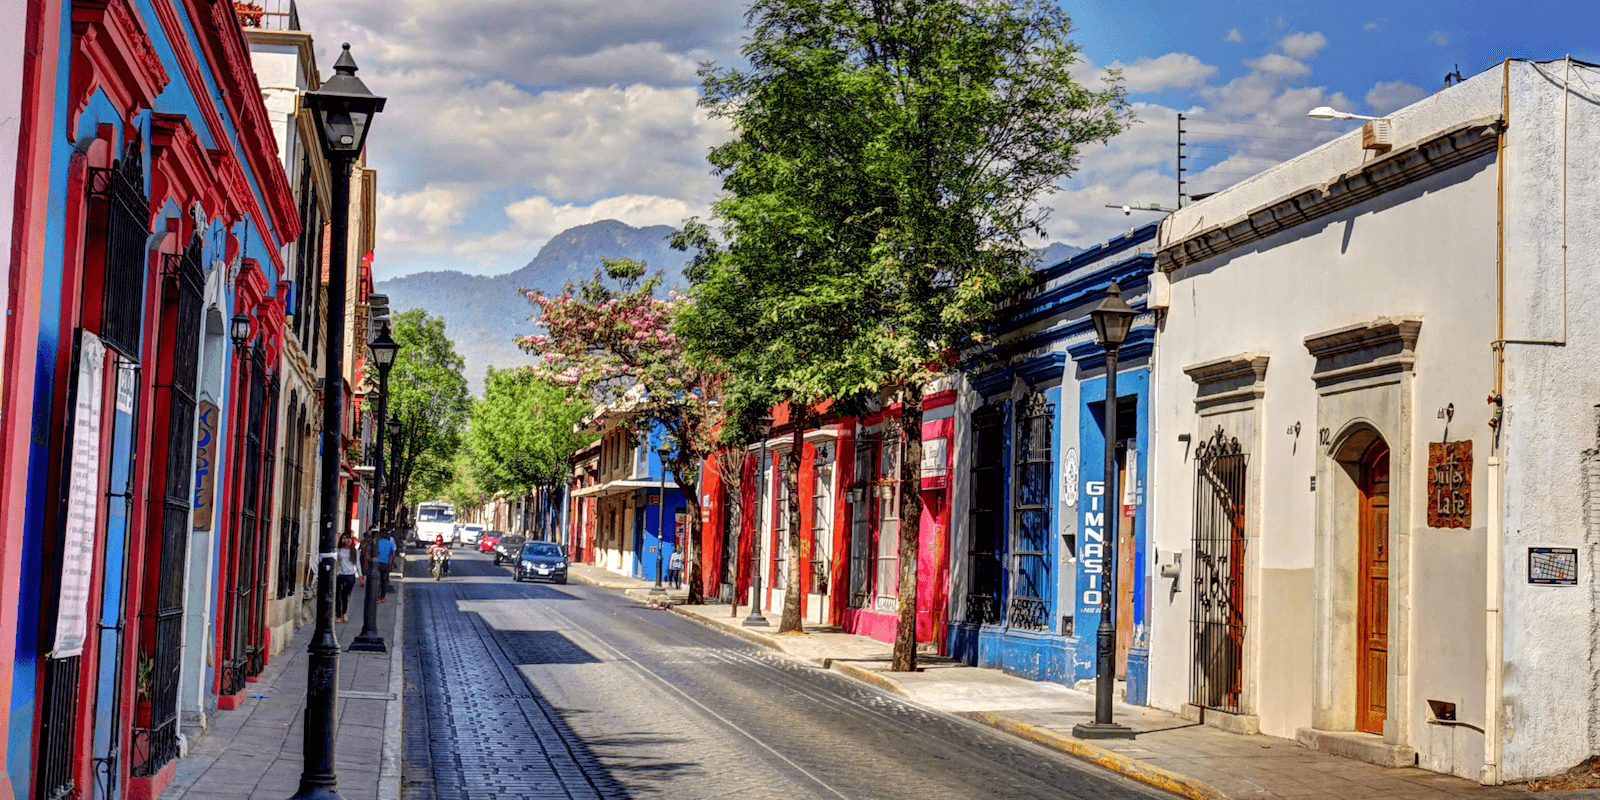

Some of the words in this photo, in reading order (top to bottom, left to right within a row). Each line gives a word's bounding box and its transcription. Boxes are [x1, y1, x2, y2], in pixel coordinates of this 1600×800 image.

[1319, 427, 1330, 446] 102
[1433, 452, 1465, 491] Suites
[1437, 489, 1450, 514] La
[1451, 491, 1465, 514] Fe
[1083, 481, 1105, 605] GIMNASIO
